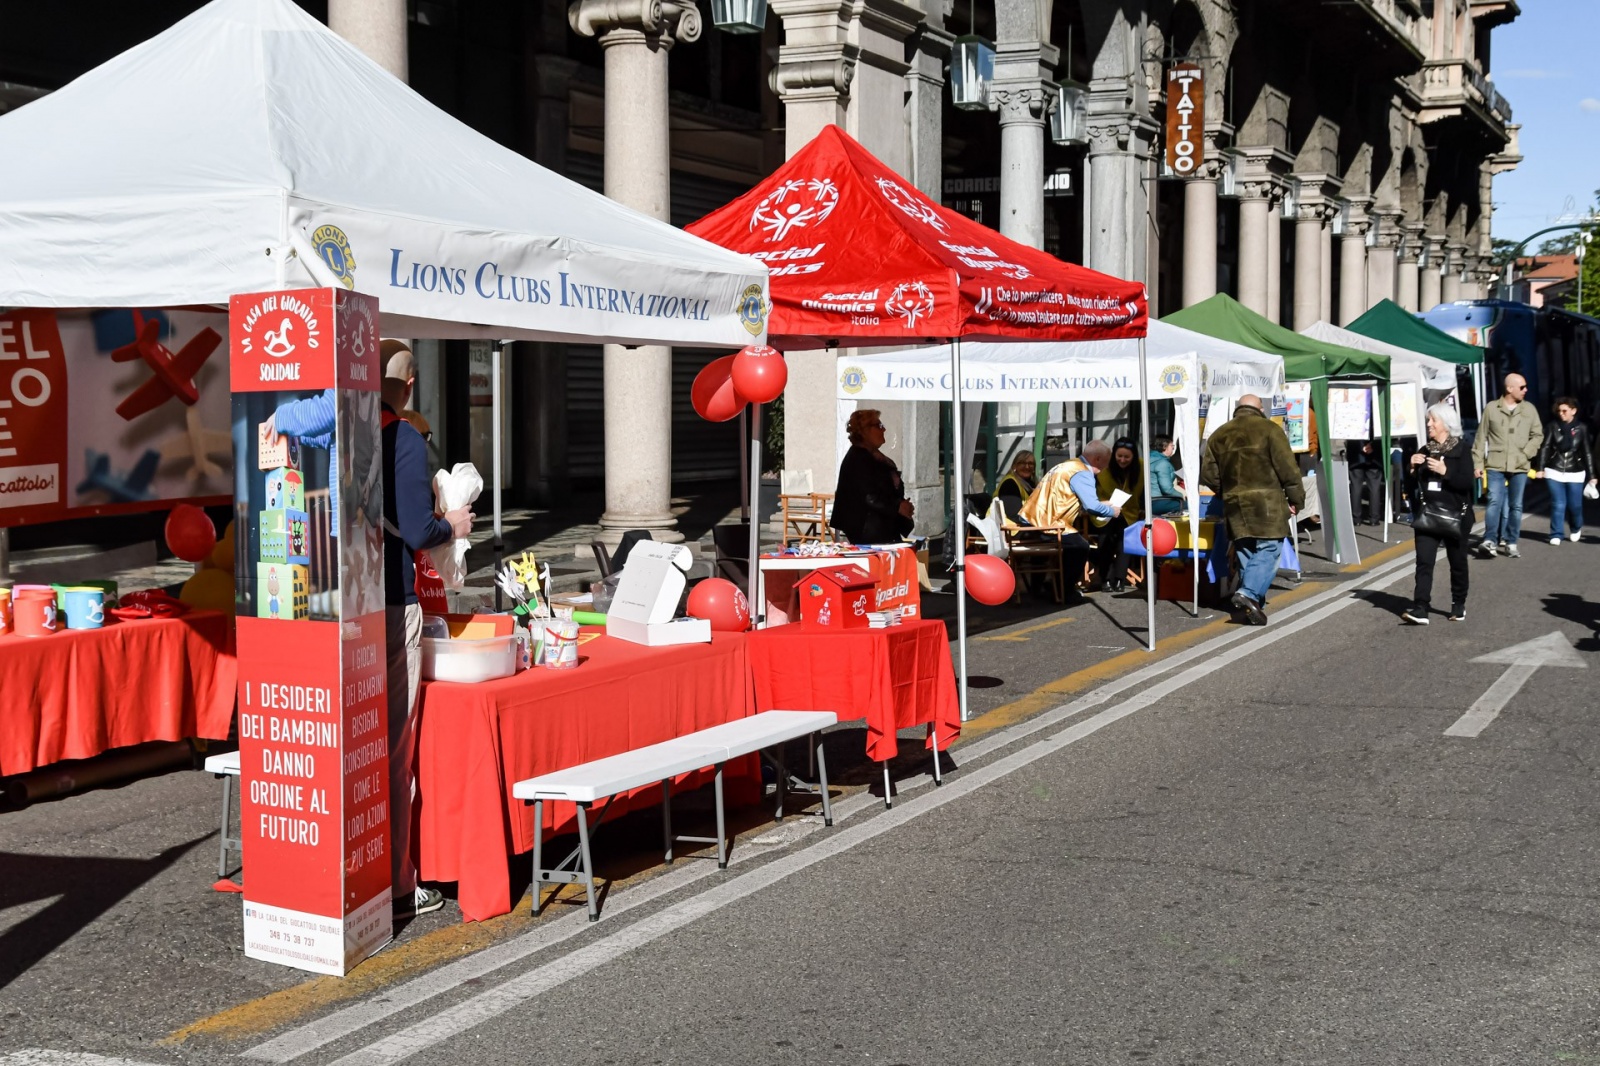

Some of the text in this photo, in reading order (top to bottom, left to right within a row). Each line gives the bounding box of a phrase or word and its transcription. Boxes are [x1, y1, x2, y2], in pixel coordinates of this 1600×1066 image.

[1174, 78, 1195, 172] TATTOO
[316, 226, 346, 245] LIONS
[325, 247, 343, 272] L
[747, 243, 826, 261] ecial
[389, 248, 711, 321] LIONS CLUBS INTERNATIONAL
[820, 288, 880, 301] Special
[801, 300, 876, 313] Olympics
[242, 304, 262, 333] CASA
[280, 295, 320, 349] GIOCATTOLO
[259, 362, 302, 381] SOLIDALE
[886, 372, 1133, 391] LIONS CUBS INTERNATIONAL
[246, 681, 331, 714] I DESIDERI
[358, 673, 384, 702] BAMBINI
[241, 713, 338, 748] DEI BAMBINI
[352, 707, 379, 738] BISOGNA
[262, 749, 315, 779] DANNO
[343, 735, 388, 775] CONSIDERARLI
[250, 780, 330, 815] ORDINE AL
[353, 771, 380, 804] COME LE
[260, 813, 319, 846] FUTURO
[347, 800, 387, 841] LORO AZIONI
[366, 833, 384, 863] SERIE
[269, 929, 281, 940] 348
[283, 933, 291, 942] 75
[303, 937, 315, 947] 737
